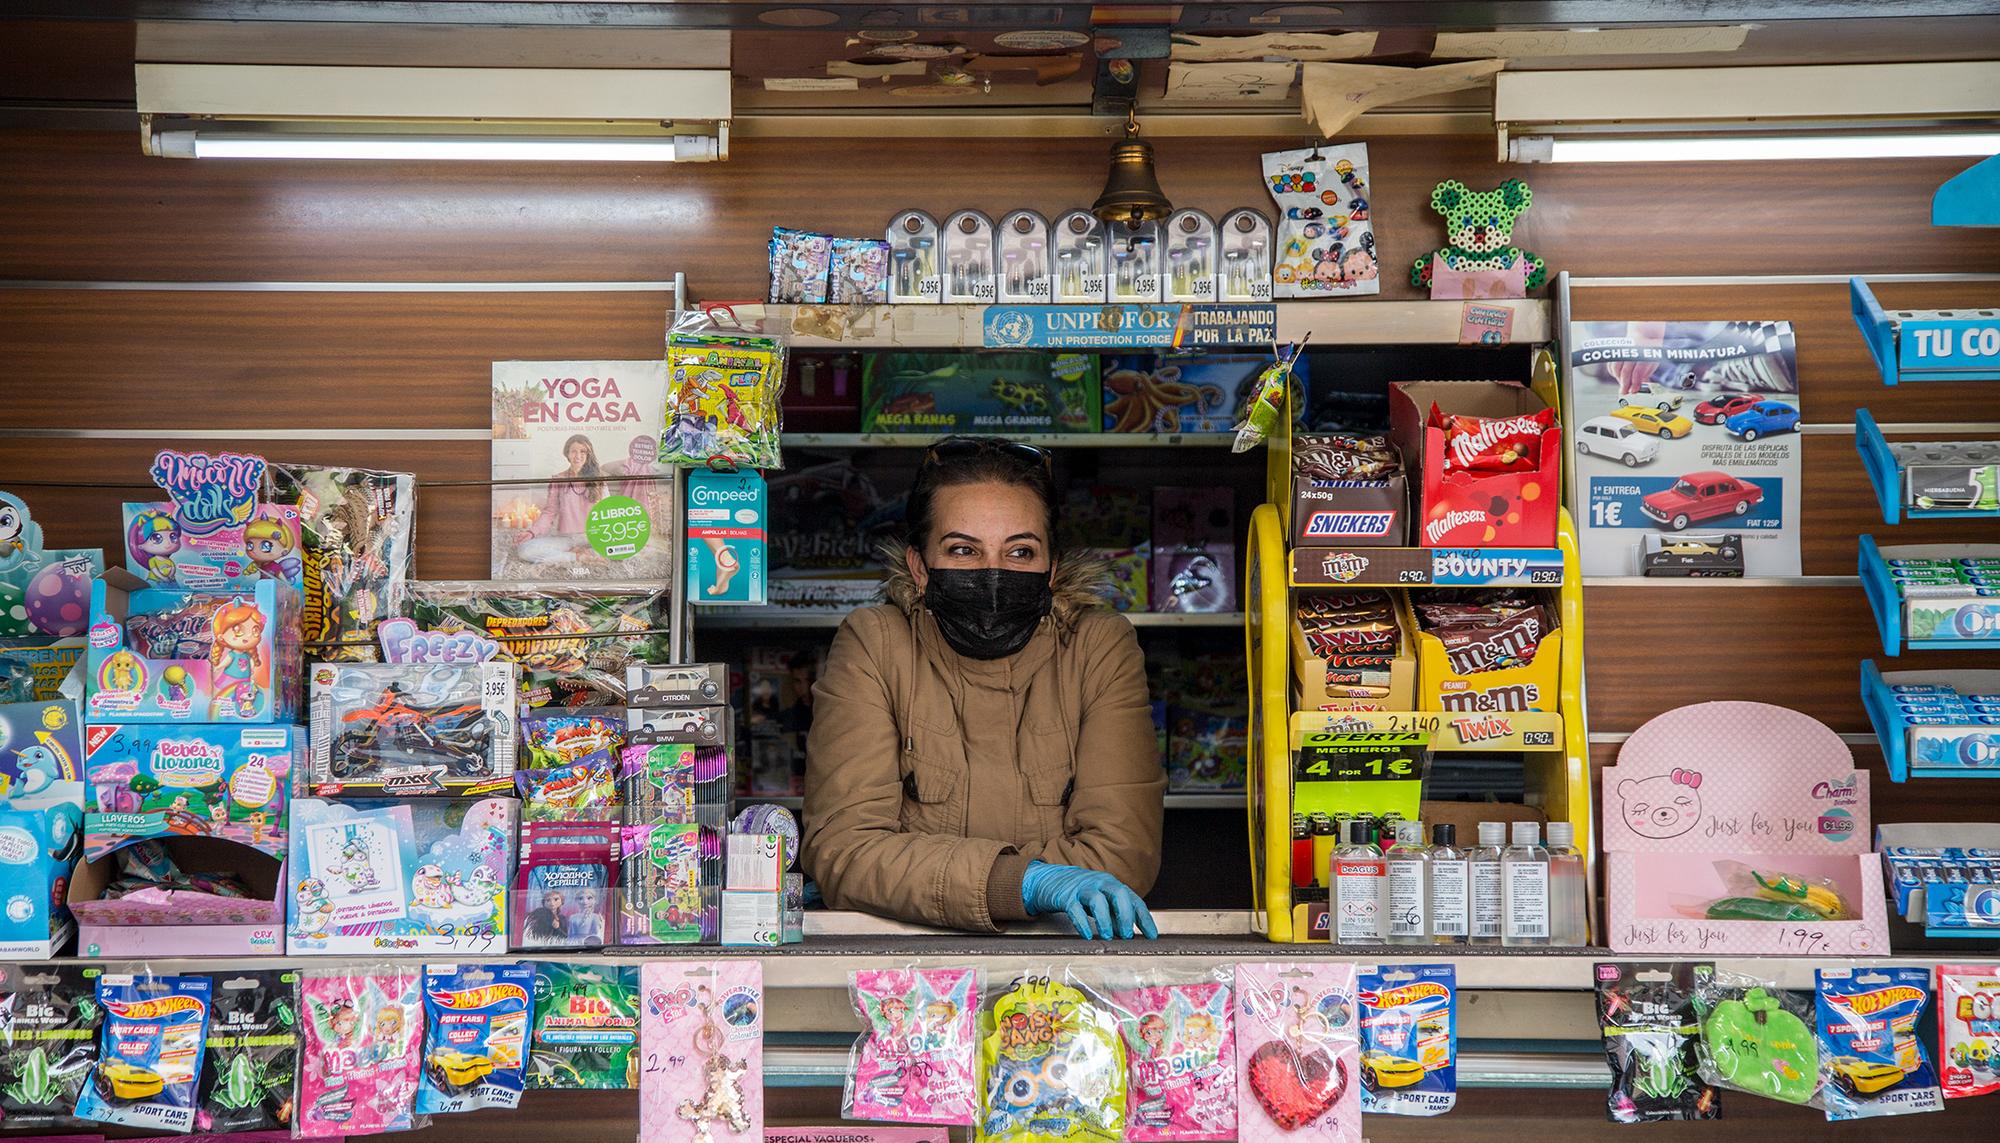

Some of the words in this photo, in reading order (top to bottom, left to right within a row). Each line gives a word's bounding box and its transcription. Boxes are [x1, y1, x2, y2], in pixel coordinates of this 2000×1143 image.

[920, 280, 939, 293] 2,95€
[975, 284, 994, 298] 2,95€
[1030, 283, 1048, 296] 2,95€
[1084, 279, 1102, 292] 2,95€
[1136, 278, 1155, 292] 2,95€
[1193, 281, 1212, 295] 2,95€
[1251, 283, 1269, 297] 2,95€
[1046, 310, 1171, 331] UNPROFOR
[1194, 310, 1274, 326] TRABAJANDO
[1048, 336, 1057, 345] UN
[1058, 335, 1132, 345] PROTECTION
[1136, 334, 1171, 344] FORCE
[1194, 328, 1220, 343] POR
[1227, 328, 1244, 343] LA
[1248, 328, 1273, 343] PAZ
[1914, 329, 1953, 357] TU
[1582, 349, 1639, 362] COCHES
[1645, 349, 1662, 359] EN
[1667, 345, 1747, 359] MINIATURA
[542, 378, 621, 398] YOGA
[524, 402, 559, 423] EN
[566, 402, 641, 423] CASA
[876, 414, 911, 425] MEGA
[973, 416, 1002, 425] MEGA
[1004, 416, 1052, 425] GRANDES
[1451, 416, 1541, 466] Maltesers
[1758, 443, 1788, 451] RÉPLICAS
[1712, 458, 1728, 466] MÁS
[1728, 458, 1778, 466] EMBLEMÁTICOS
[159, 455, 256, 497] Unicorn
[1603, 486, 1641, 495] ENTREGA
[1967, 468, 1987, 509] 5
[692, 486, 758, 506] Compeed
[1301, 491, 1333, 501] 24x50g
[184, 486, 235, 524] dolls
[285, 511, 296, 519] 3+
[592, 511, 599, 521] 2
[600, 506, 642, 520] LIBROS
[1592, 502, 1623, 526] 1€
[1310, 514, 1390, 533] SNICKERS
[1426, 509, 1486, 544] Maltesers
[1747, 519, 1761, 527] FIAT
[600, 521, 647, 544] 3,95€
[1434, 557, 1528, 577] BOUNTY
[486, 616, 550, 628] DEPREDADORES
[386, 623, 495, 663] FREEZY
[1326, 671, 1361, 685] Mars
[485, 682, 506, 696] 3,95€
[1443, 681, 1468, 690] PEANUT
[1347, 688, 1370, 697] Twix
[1454, 715, 1514, 742] Twix
[88, 728, 109, 748] NEW
[1310, 733, 1421, 742] OFERTA
[162, 741, 207, 757] Bebés
[1316, 746, 1401, 754] MECHEROS
[154, 753, 221, 770] llorones
[250, 755, 264, 768] 24
[1306, 761, 1331, 776] 4
[1365, 759, 1413, 775] 1€
[101, 814, 145, 824] LLAVEROS
[1705, 815, 1742, 838] Just
[1751, 812, 1773, 836] for
[1784, 817, 1815, 842] You
[544, 872, 594, 881] ХОЛОДНОЕ
[1342, 866, 1378, 874] DeAGUS
[436, 924, 496, 952] 3,99
[1624, 926, 1660, 946] Just
[1667, 922, 1688, 943] for
[1697, 926, 1728, 950] You
[427, 979, 437, 987] 3+
[1822, 982, 1833, 990] 3+
[27, 1005, 54, 1018] BIG
[569, 996, 610, 1014] BIG
[1643, 1002, 1669, 1014] BIG
[228, 1011, 255, 1024] BIG
[462, 1014, 486, 1023] CARS!
[545, 1016, 587, 1026] ANIMAL
[591, 1016, 635, 1027] WORLD
[663, 1008, 683, 1022] Star
[135, 1025, 158, 1035] CARS!
[242, 1023, 268, 1031] WORLD
[449, 1031, 477, 1040] COLLECT
[118, 1043, 149, 1051] COLLECT
[646, 1053, 686, 1073] 2,99
[470, 1089, 494, 1098] SPORT
[495, 1090, 514, 1100] CARS
[1429, 1095, 1450, 1104] CARS
[1879, 1094, 1909, 1104] SPORT
[132, 1107, 163, 1116] SPORT
[165, 1109, 188, 1119] CARS
